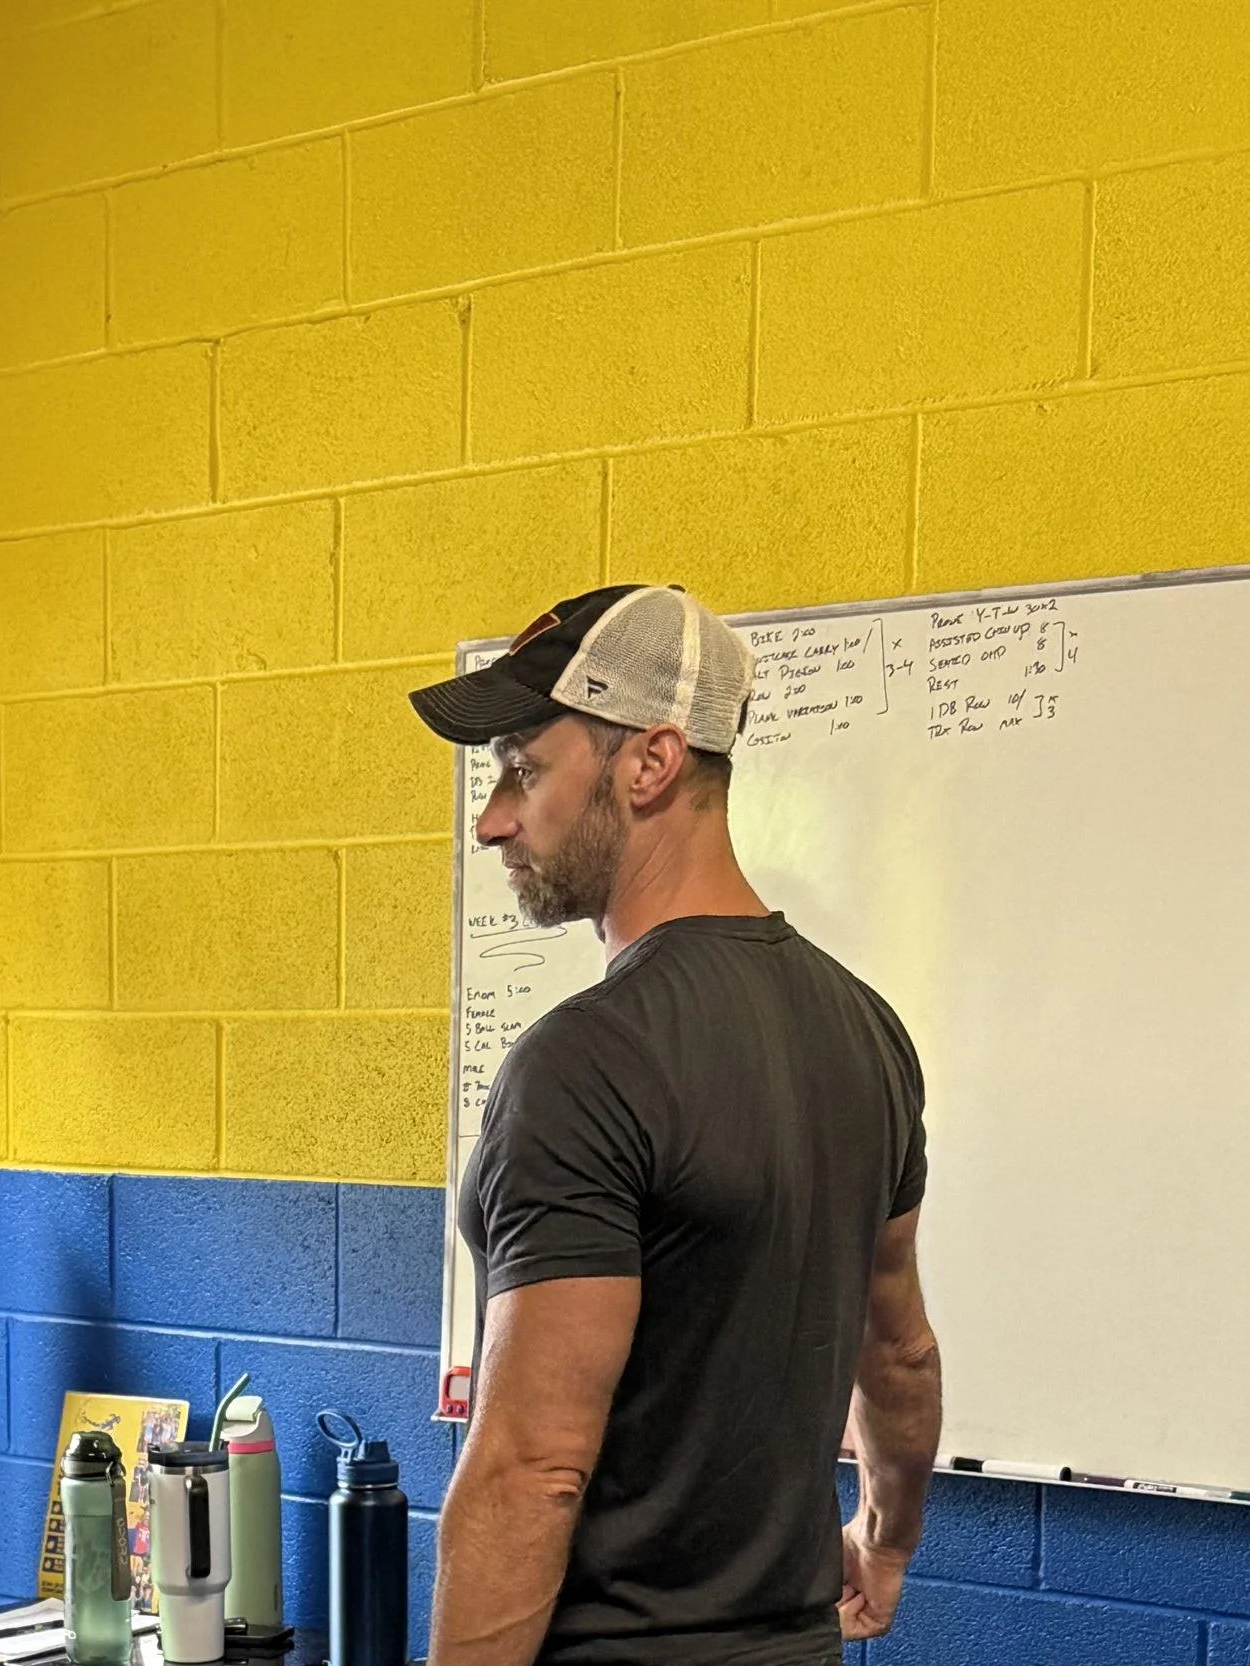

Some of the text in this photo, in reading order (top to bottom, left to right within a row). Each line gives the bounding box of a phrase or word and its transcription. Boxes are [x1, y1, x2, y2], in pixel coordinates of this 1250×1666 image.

[750, 630, 783, 647] BIKE
[929, 632, 981, 652] ASSISTED
[1040, 622, 1050, 634] 8
[927, 676, 959, 693] REST
[468, 915, 497, 927] WEEK
